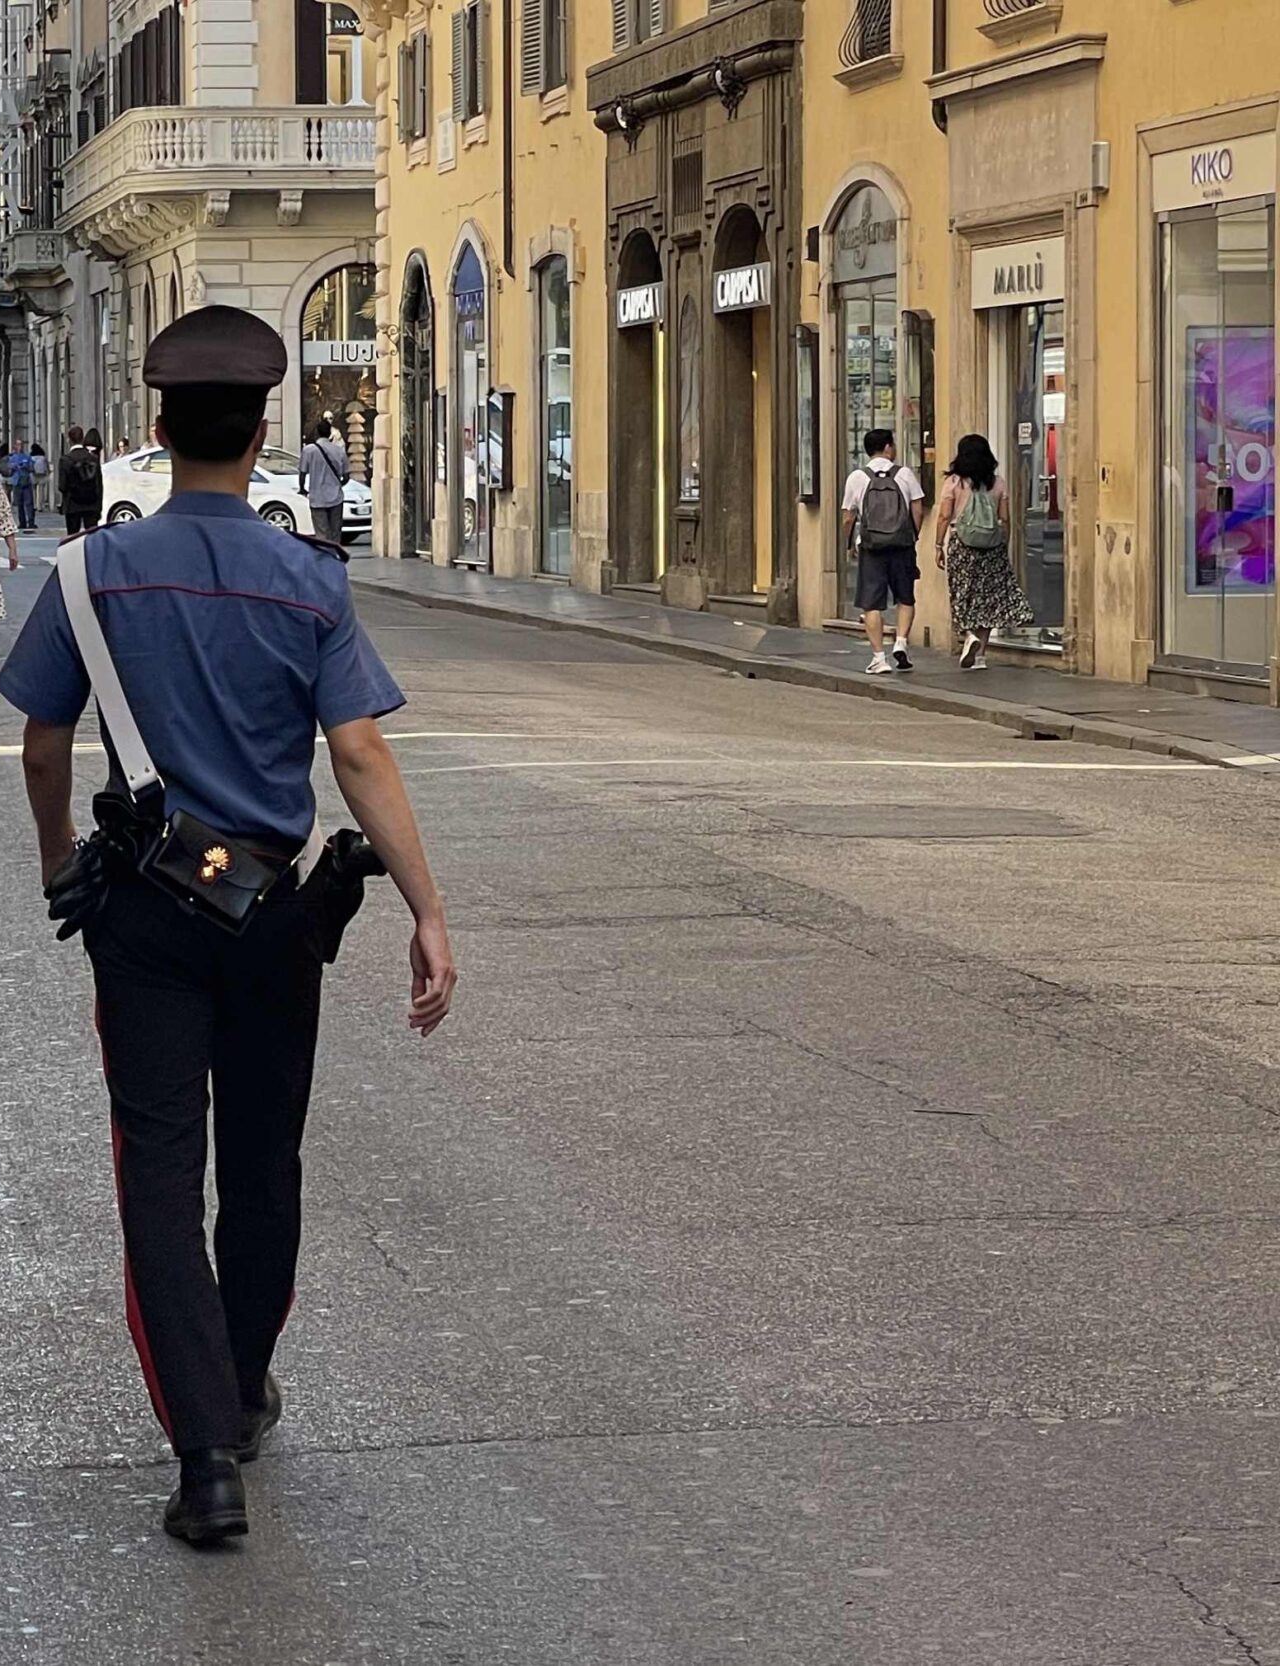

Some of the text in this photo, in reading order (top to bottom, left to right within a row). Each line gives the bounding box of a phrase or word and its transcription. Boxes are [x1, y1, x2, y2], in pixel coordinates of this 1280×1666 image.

[334, 19, 359, 29] MAX
[1191, 148, 1232, 185] KIKO
[716, 268, 759, 308] CARPISA
[993, 251, 1043, 295] MARLÙ
[620, 287, 655, 323] CARPISA
[330, 343, 379, 362] LIU·J
